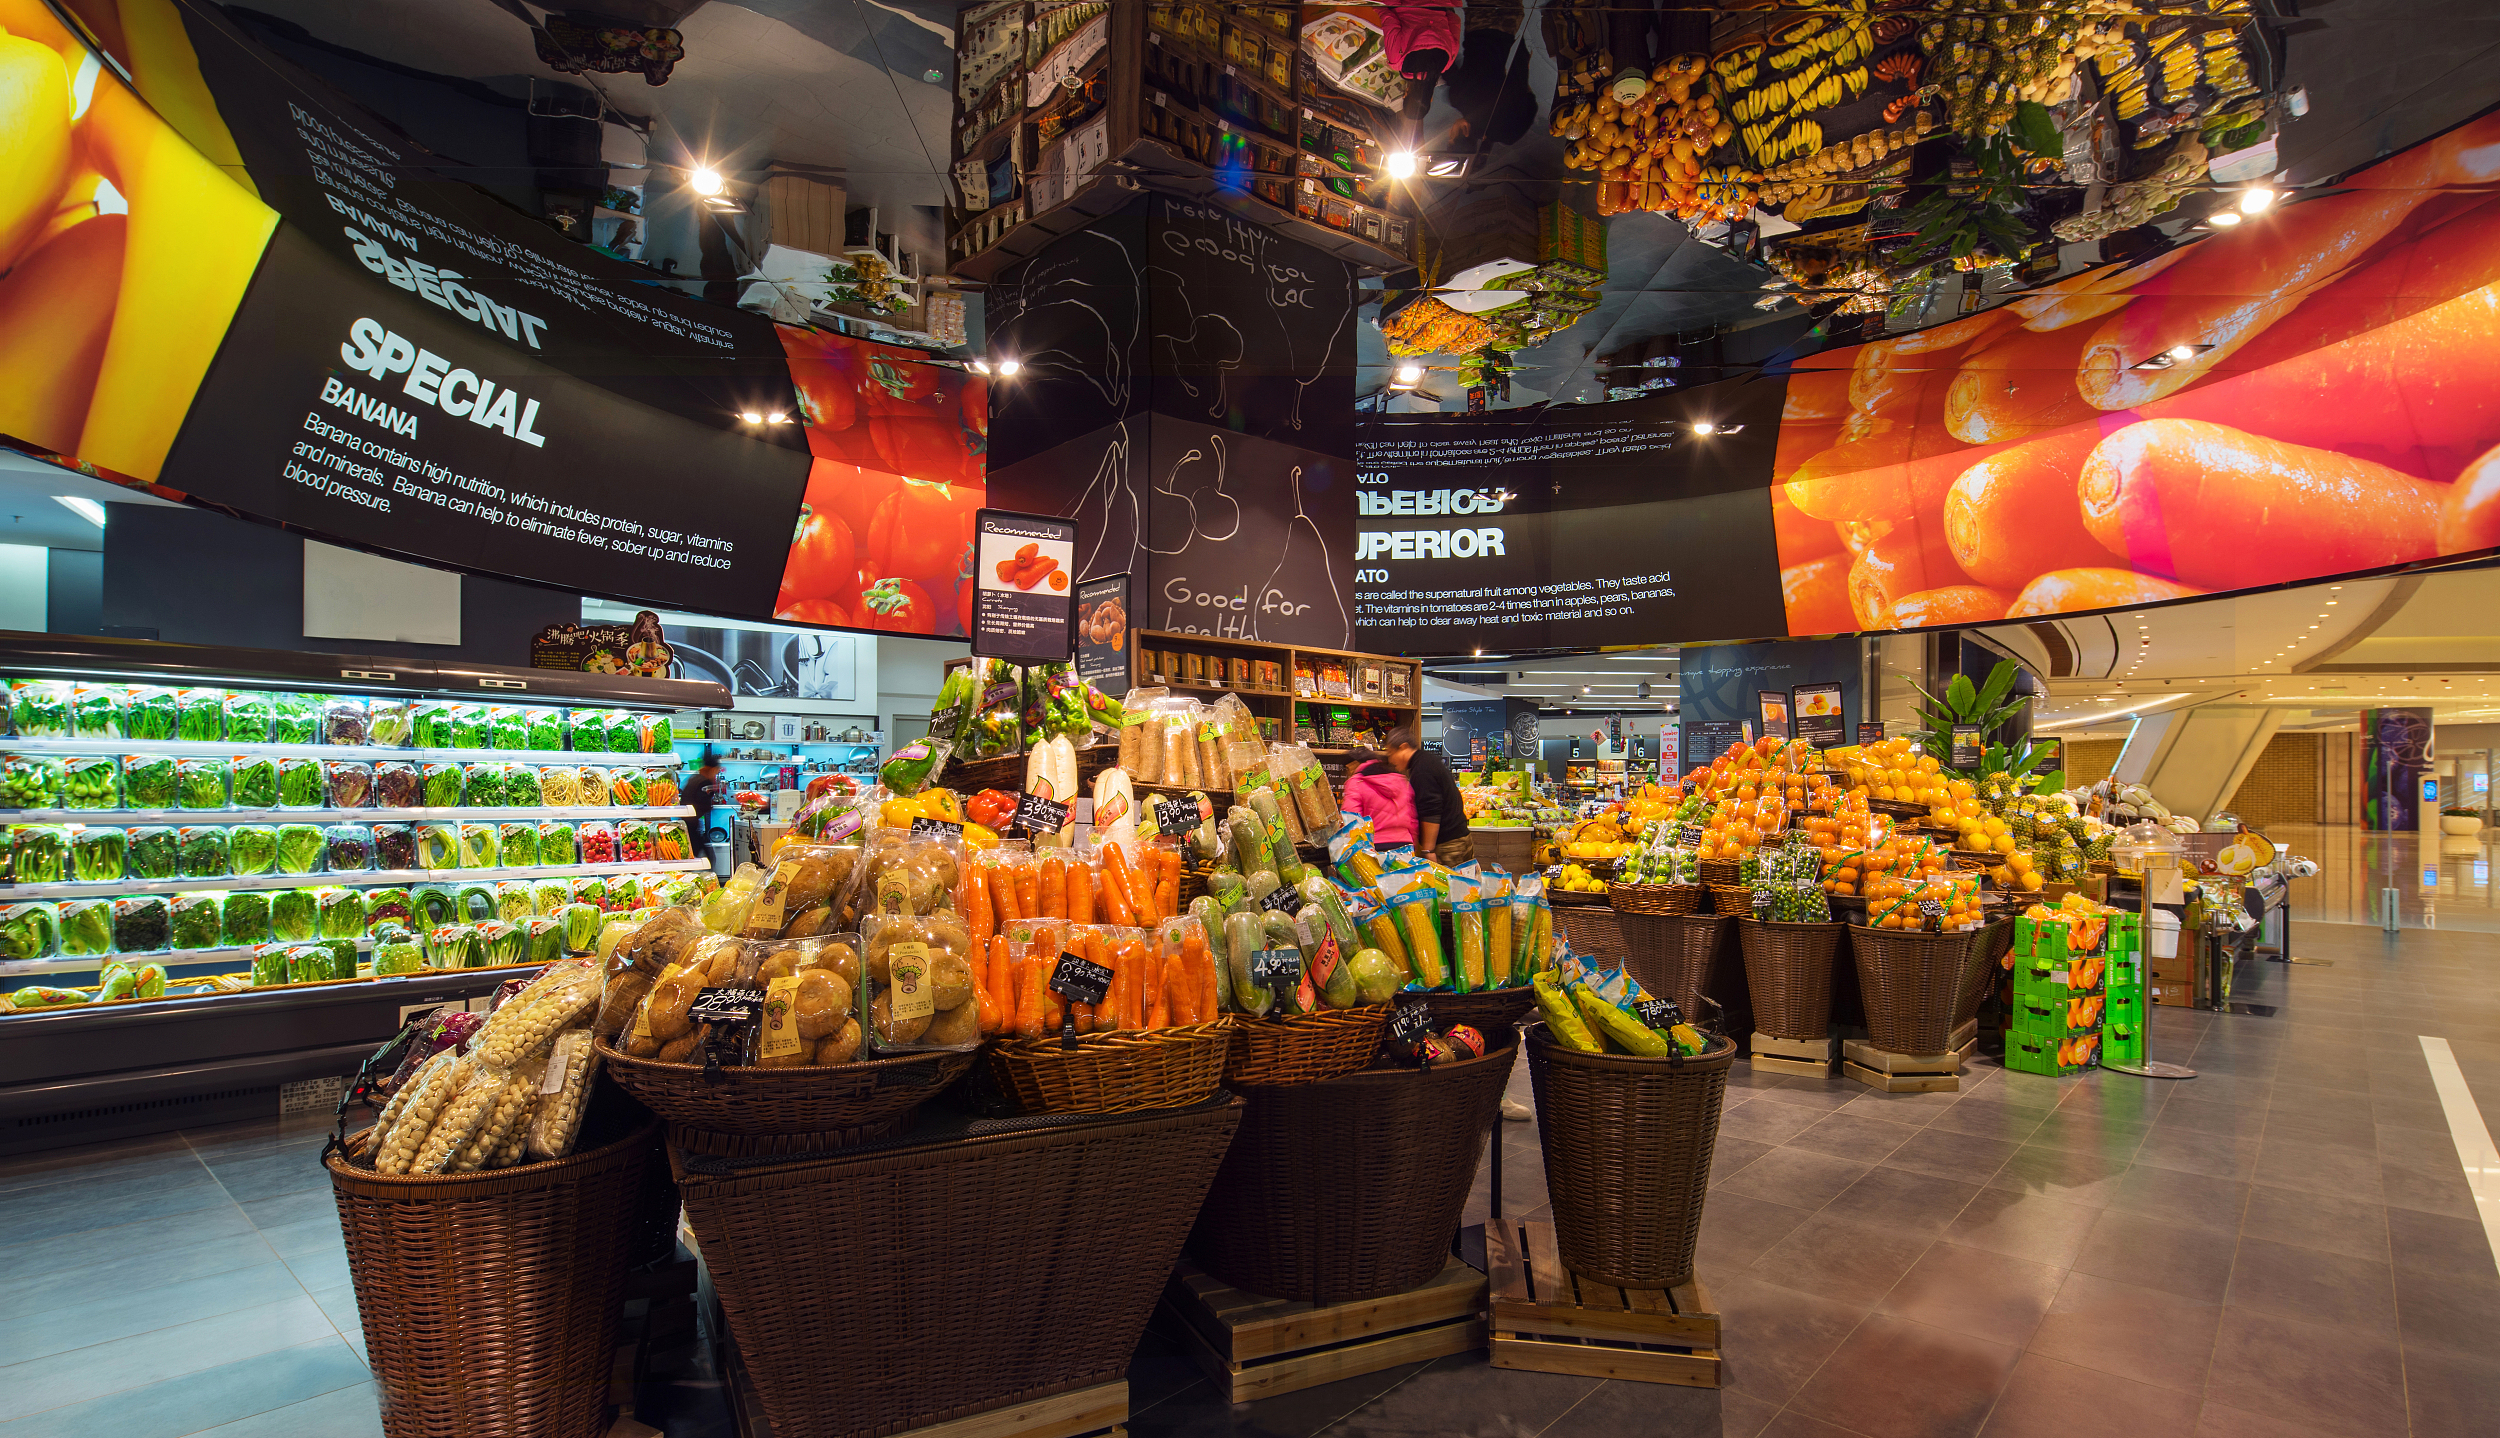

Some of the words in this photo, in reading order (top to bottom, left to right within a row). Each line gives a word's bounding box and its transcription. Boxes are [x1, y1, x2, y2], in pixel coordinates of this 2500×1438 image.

[341, 318, 547, 448] SPECIAL
[320, 377, 418, 440] BANANA
[282, 460, 329, 492] blood
[326, 478, 392, 514] pressure.
[304, 412, 360, 450] Banana
[362, 440, 420, 473] contains
[421, 459, 452, 484] high
[453, 473, 506, 502] nutrition,
[511, 492, 549, 513] which
[550, 500, 600, 526] includes
[600, 515, 645, 539] protein,
[648, 525, 684, 546] sugar,
[686, 534, 734, 552] vitamins
[292, 440, 327, 464] and
[323, 450, 386, 488] minerals.
[392, 476, 446, 507] Banana
[448, 497, 474, 514] can
[475, 503, 504, 526] help
[506, 510, 520, 527] to
[520, 517, 576, 541] eliminate
[577, 528, 609, 550] fever,
[611, 538, 646, 556] sober
[647, 545, 664, 562] up
[665, 550, 690, 564] and
[690, 554, 732, 570] reduce
[984, 522, 1062, 540] Recommended
[1355, 568, 1389, 583] ATO
[1364, 592, 1380, 600] are
[1380, 590, 1408, 600] called
[1408, 590, 1424, 599] the
[1425, 587, 1482, 600] supernatural
[1484, 587, 1502, 598] fruit
[1502, 586, 1538, 596] among
[1538, 580, 1594, 594] vegetables.
[1595, 578, 1621, 590] They
[1622, 575, 1648, 586] taste
[1648, 571, 1671, 583] acid
[1080, 582, 1120, 600] Recommended
[1164, 577, 1248, 611] Good
[1262, 588, 1312, 616] for
[1364, 604, 1383, 614] The
[1384, 603, 1420, 614] vitamins
[1420, 603, 1429, 612] in
[1430, 602, 1473, 612] tomatoes
[1474, 603, 1489, 612] are
[1490, 601, 1506, 610] 2-4
[1506, 600, 1532, 610] times
[1533, 598, 1555, 608] than
[1556, 596, 1564, 606] in
[1564, 595, 1599, 608] apples,
[1600, 592, 1630, 606] pears,
[1630, 588, 1676, 602] bananas,
[1378, 618, 1396, 627] can
[1398, 616, 1417, 628] help
[1418, 616, 1429, 626] to
[1430, 616, 1452, 626] clear
[1453, 616, 1478, 626] away
[1480, 614, 1500, 624] heat
[1501, 612, 1520, 623] and
[1521, 612, 1544, 622] toxic
[1546, 608, 1582, 621] material
[1584, 607, 1603, 618] and
[1604, 607, 1617, 616] so
[1619, 606, 1636, 616] on.
[1469, 706, 1482, 716] Style
[1572, 748, 1580, 758] 5
[1638, 748, 1645, 758] 6
[1158, 808, 1180, 828] 13.90
[1254, 958, 1281, 977] 4.90
[692, 995, 742, 1011] 28.90
[1640, 1006, 1662, 1020] 7.80
[1392, 1016, 1410, 1038] 11.90
